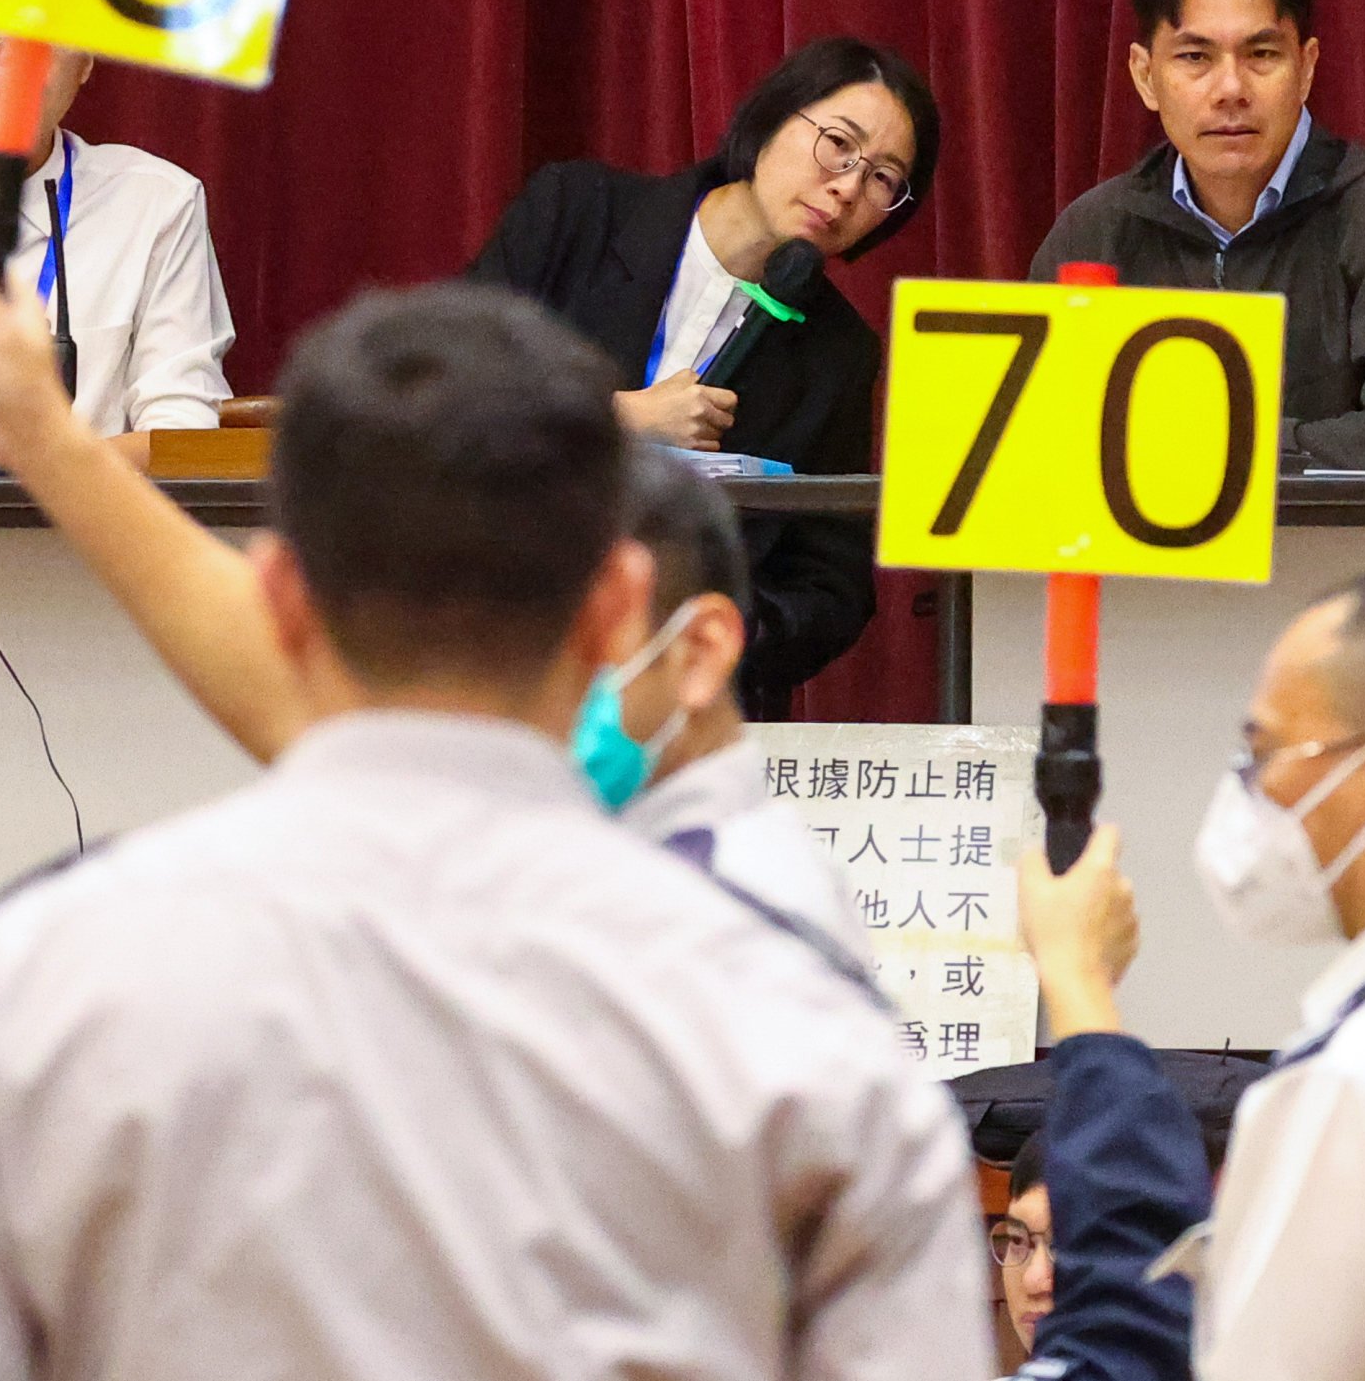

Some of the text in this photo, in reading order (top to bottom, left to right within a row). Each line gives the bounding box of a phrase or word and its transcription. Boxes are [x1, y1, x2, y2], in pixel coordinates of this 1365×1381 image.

[914, 310, 1256, 549] 70
[765, 757, 998, 801] 根據防止賄
[873, 955, 985, 997] ，或
